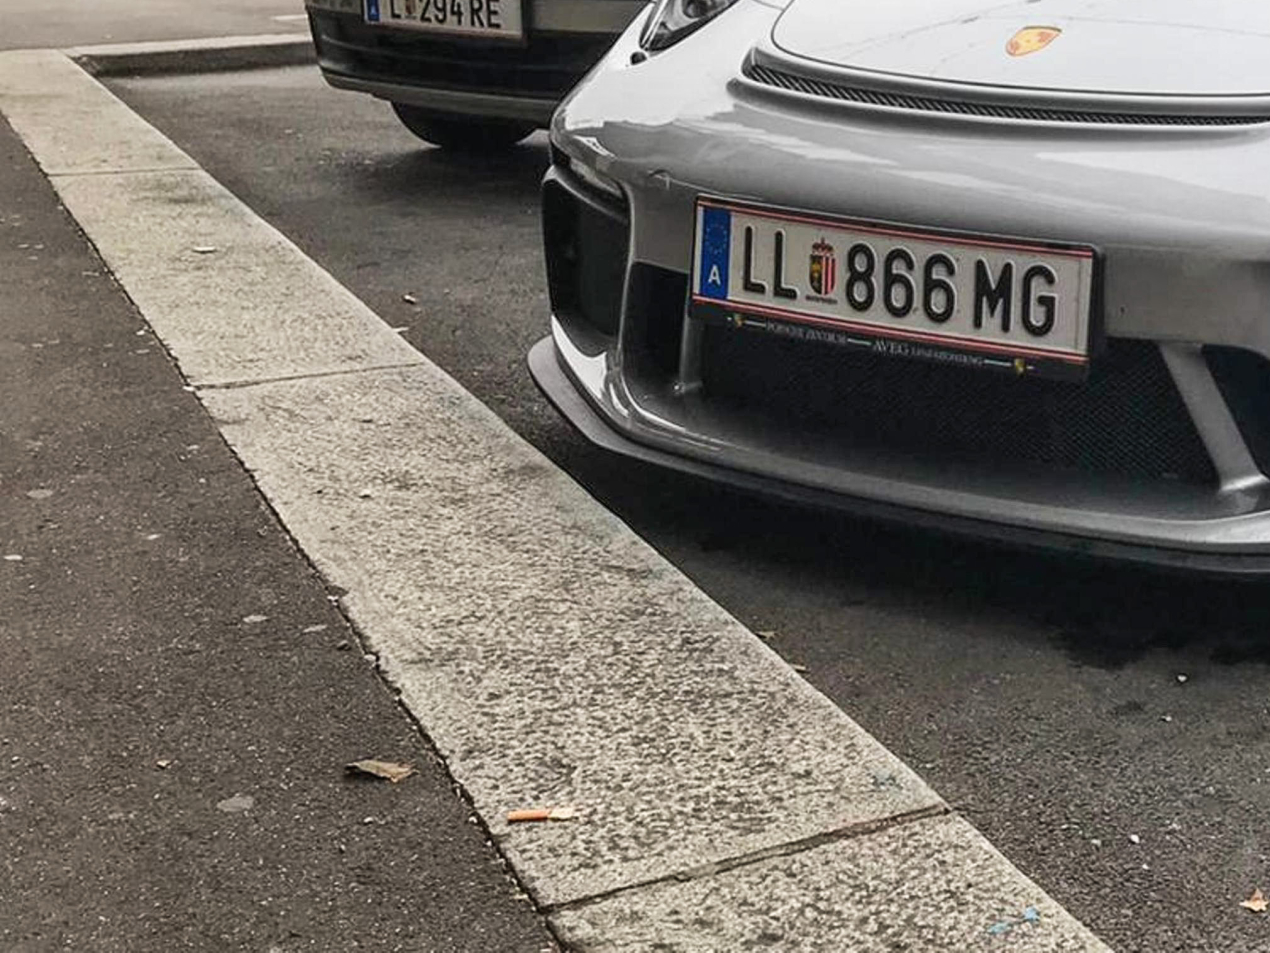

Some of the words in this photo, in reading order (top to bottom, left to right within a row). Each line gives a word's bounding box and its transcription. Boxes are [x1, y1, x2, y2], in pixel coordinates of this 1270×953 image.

[707, 264, 722, 286] A
[742, 225, 798, 299] LL
[845, 242, 956, 323] 866
[974, 258, 1057, 337] MG
